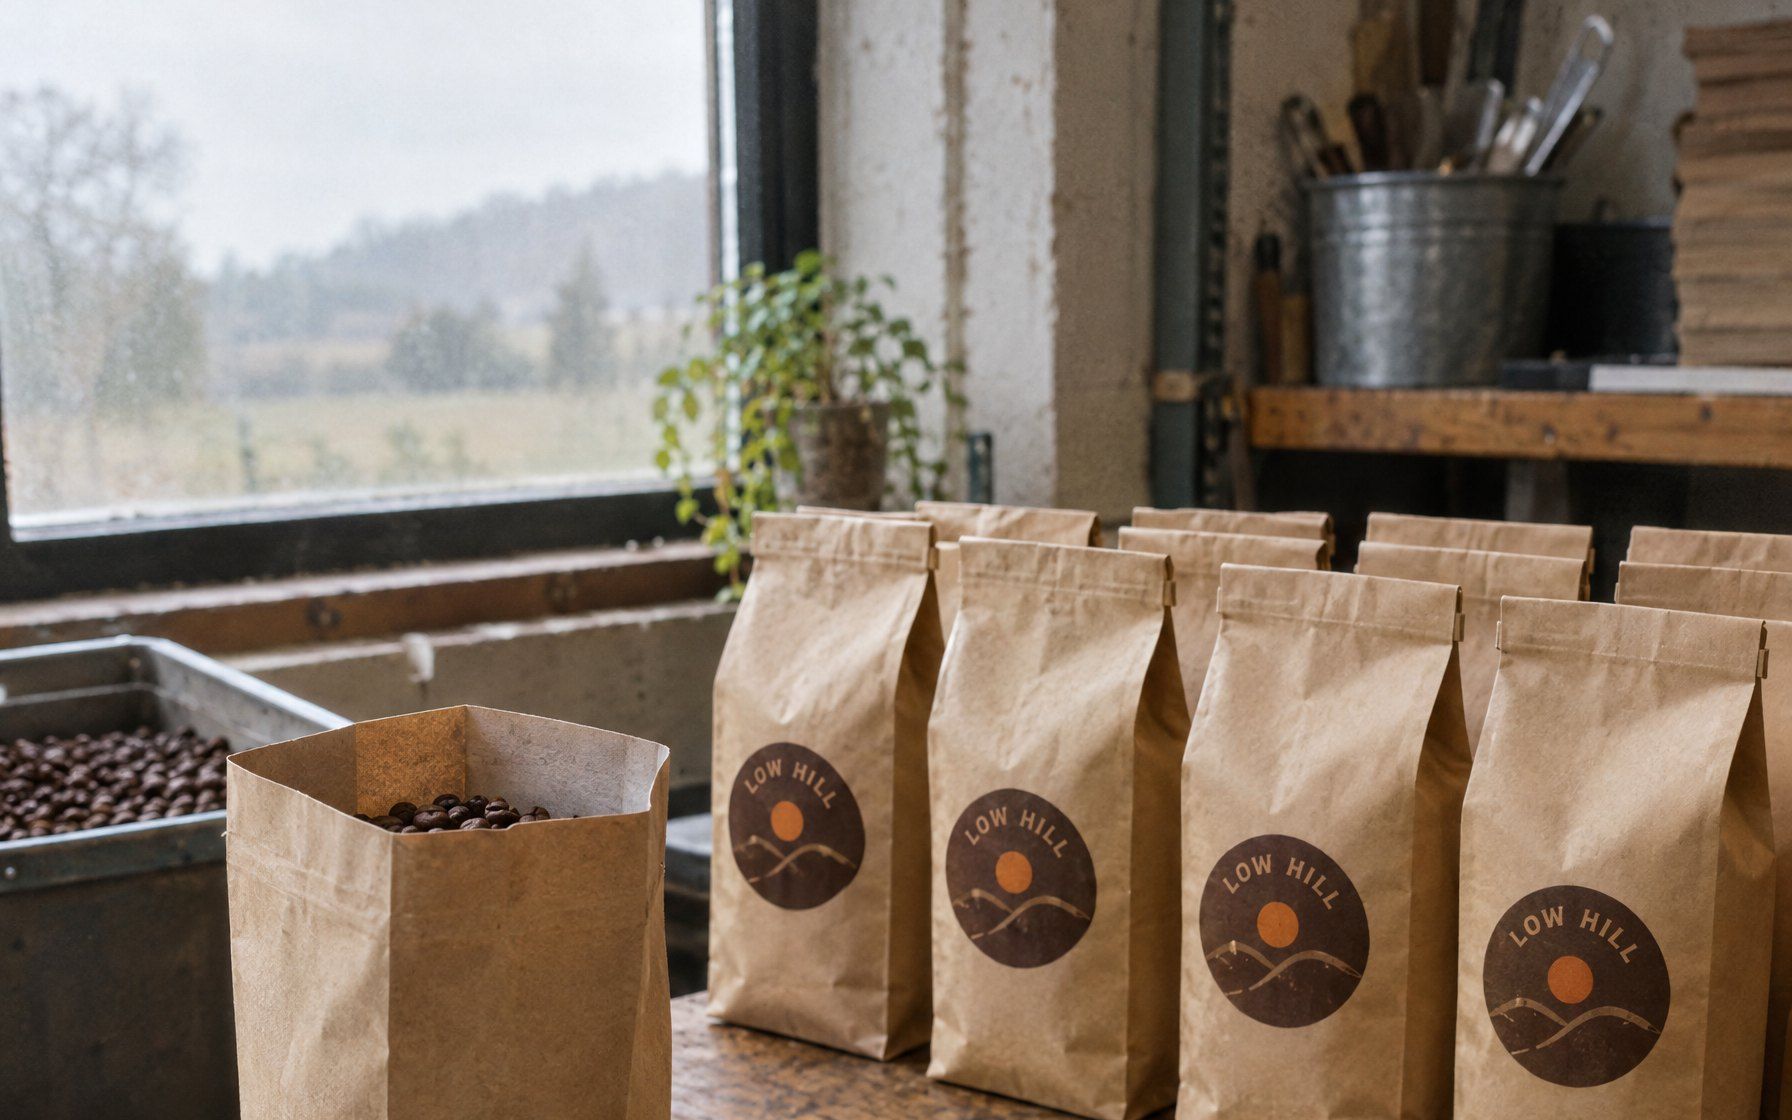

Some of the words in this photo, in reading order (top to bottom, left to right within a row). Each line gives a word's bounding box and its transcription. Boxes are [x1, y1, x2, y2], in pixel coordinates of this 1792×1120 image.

[744, 758, 783, 794] LOW
[792, 761, 837, 810] HILL
[964, 806, 1008, 846] LOW
[1019, 808, 1073, 859] HILL
[1222, 853, 1272, 895] LOW
[1286, 857, 1341, 911] HILL
[1508, 905, 1564, 948] LOW
[1579, 908, 1639, 965] HILL
